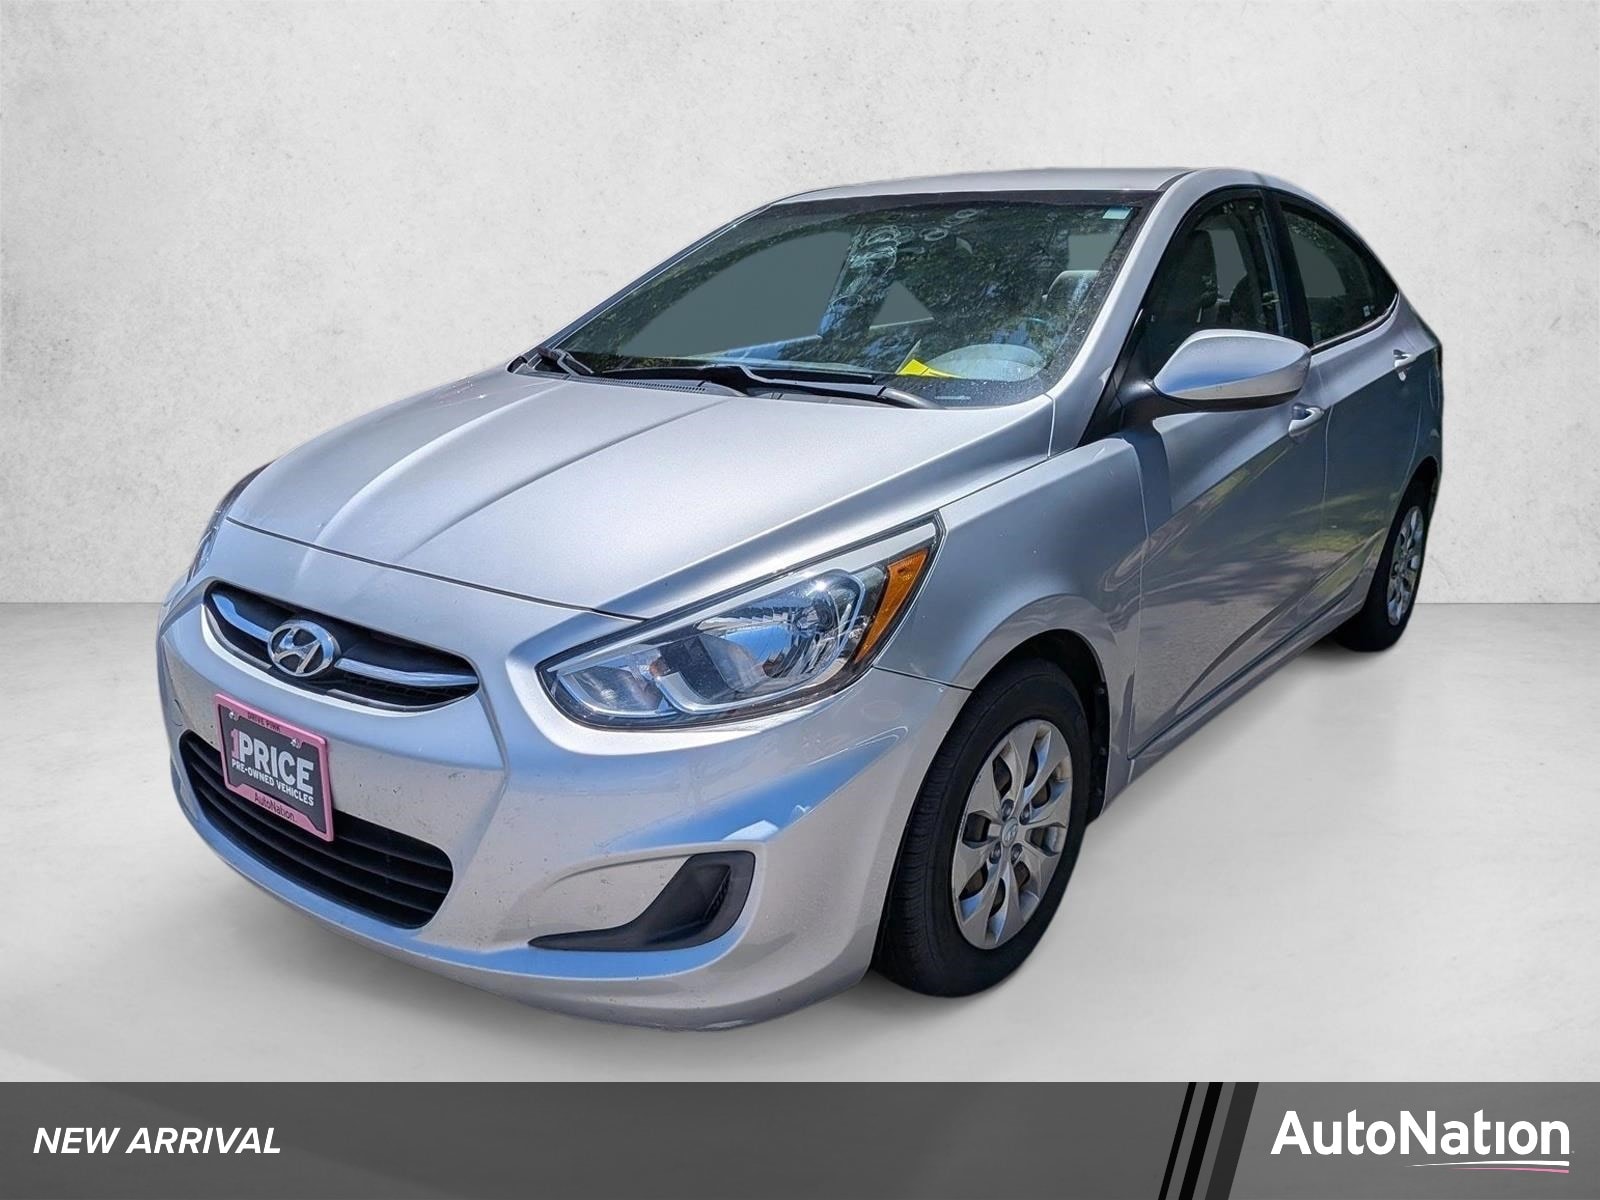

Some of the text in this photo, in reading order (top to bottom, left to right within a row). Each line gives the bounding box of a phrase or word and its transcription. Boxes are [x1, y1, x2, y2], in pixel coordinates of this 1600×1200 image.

[232, 758, 314, 806] PRE-OWNED VEHICLES
[254, 792, 295, 821] AutoNation
